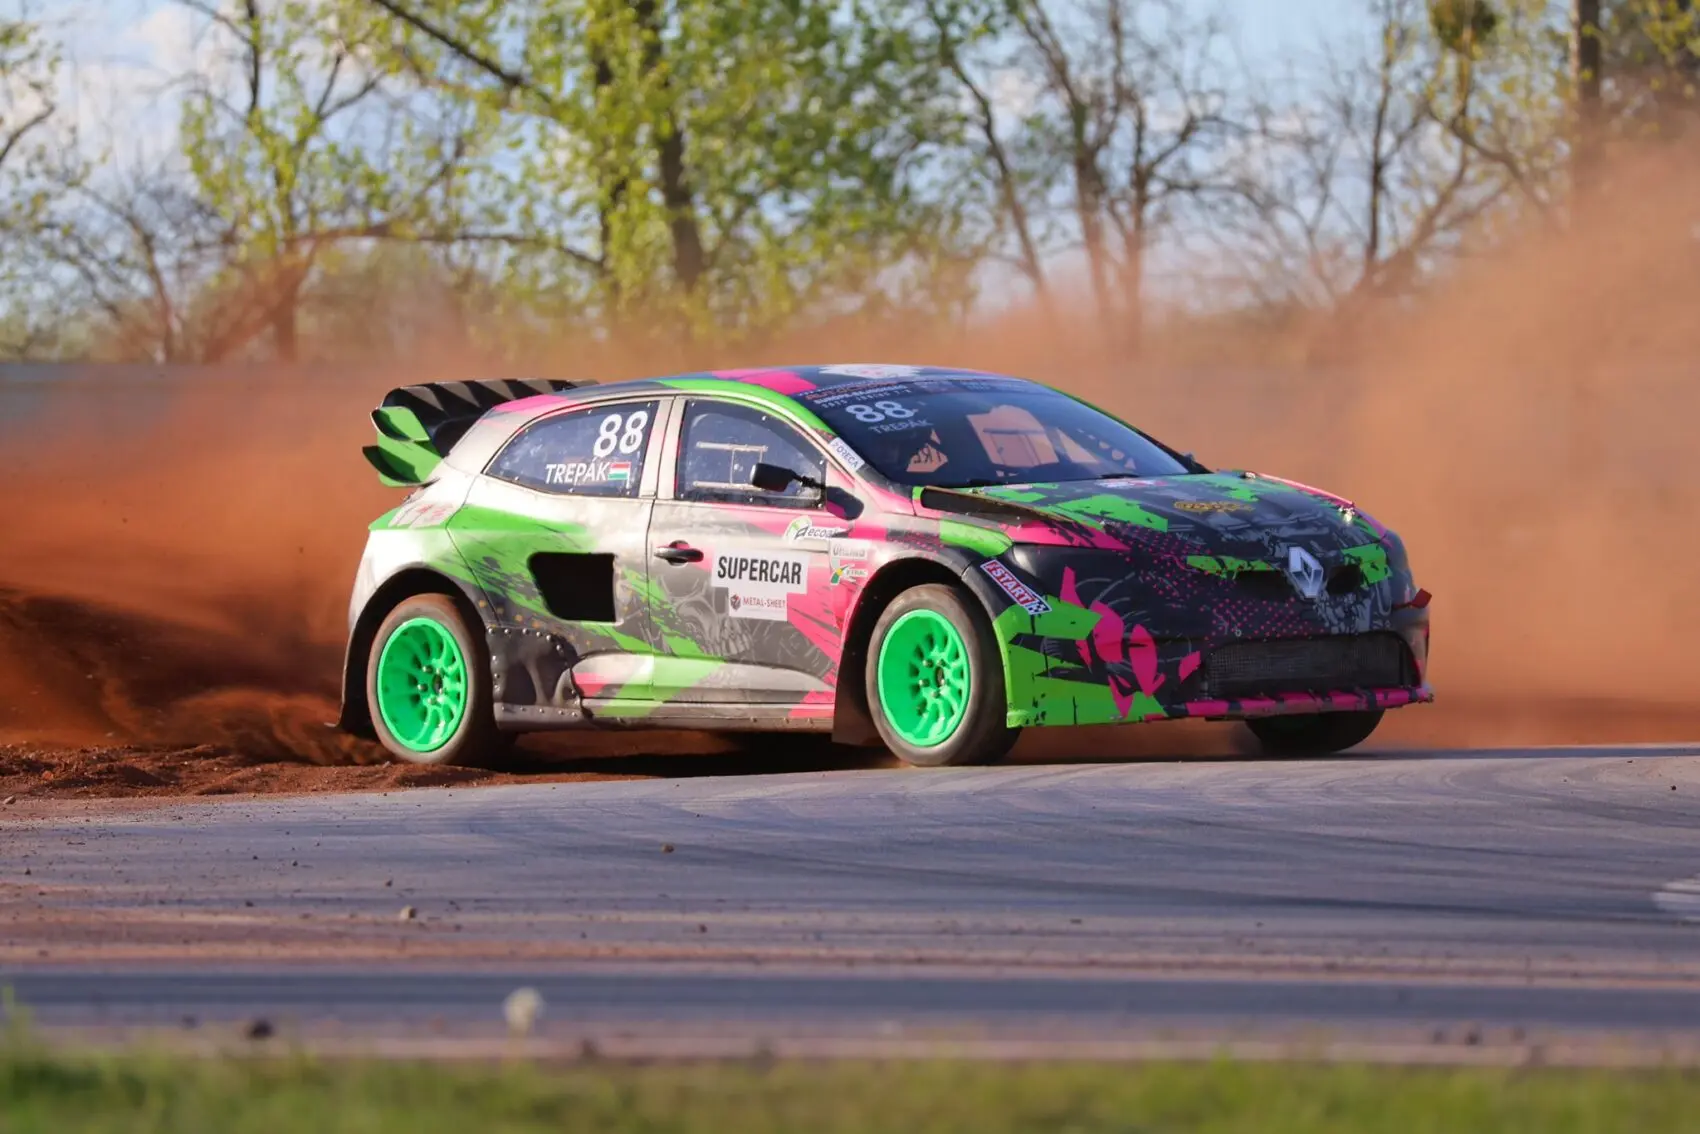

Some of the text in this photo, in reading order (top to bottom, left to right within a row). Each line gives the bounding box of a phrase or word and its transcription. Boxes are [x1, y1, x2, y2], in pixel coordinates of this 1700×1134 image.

[845, 400, 915, 422] 88
[593, 410, 648, 458] 88
[544, 457, 610, 484] TREPÁK
[717, 555, 802, 585] SUPERCAR
[742, 595, 786, 609] METAL-SHEET
